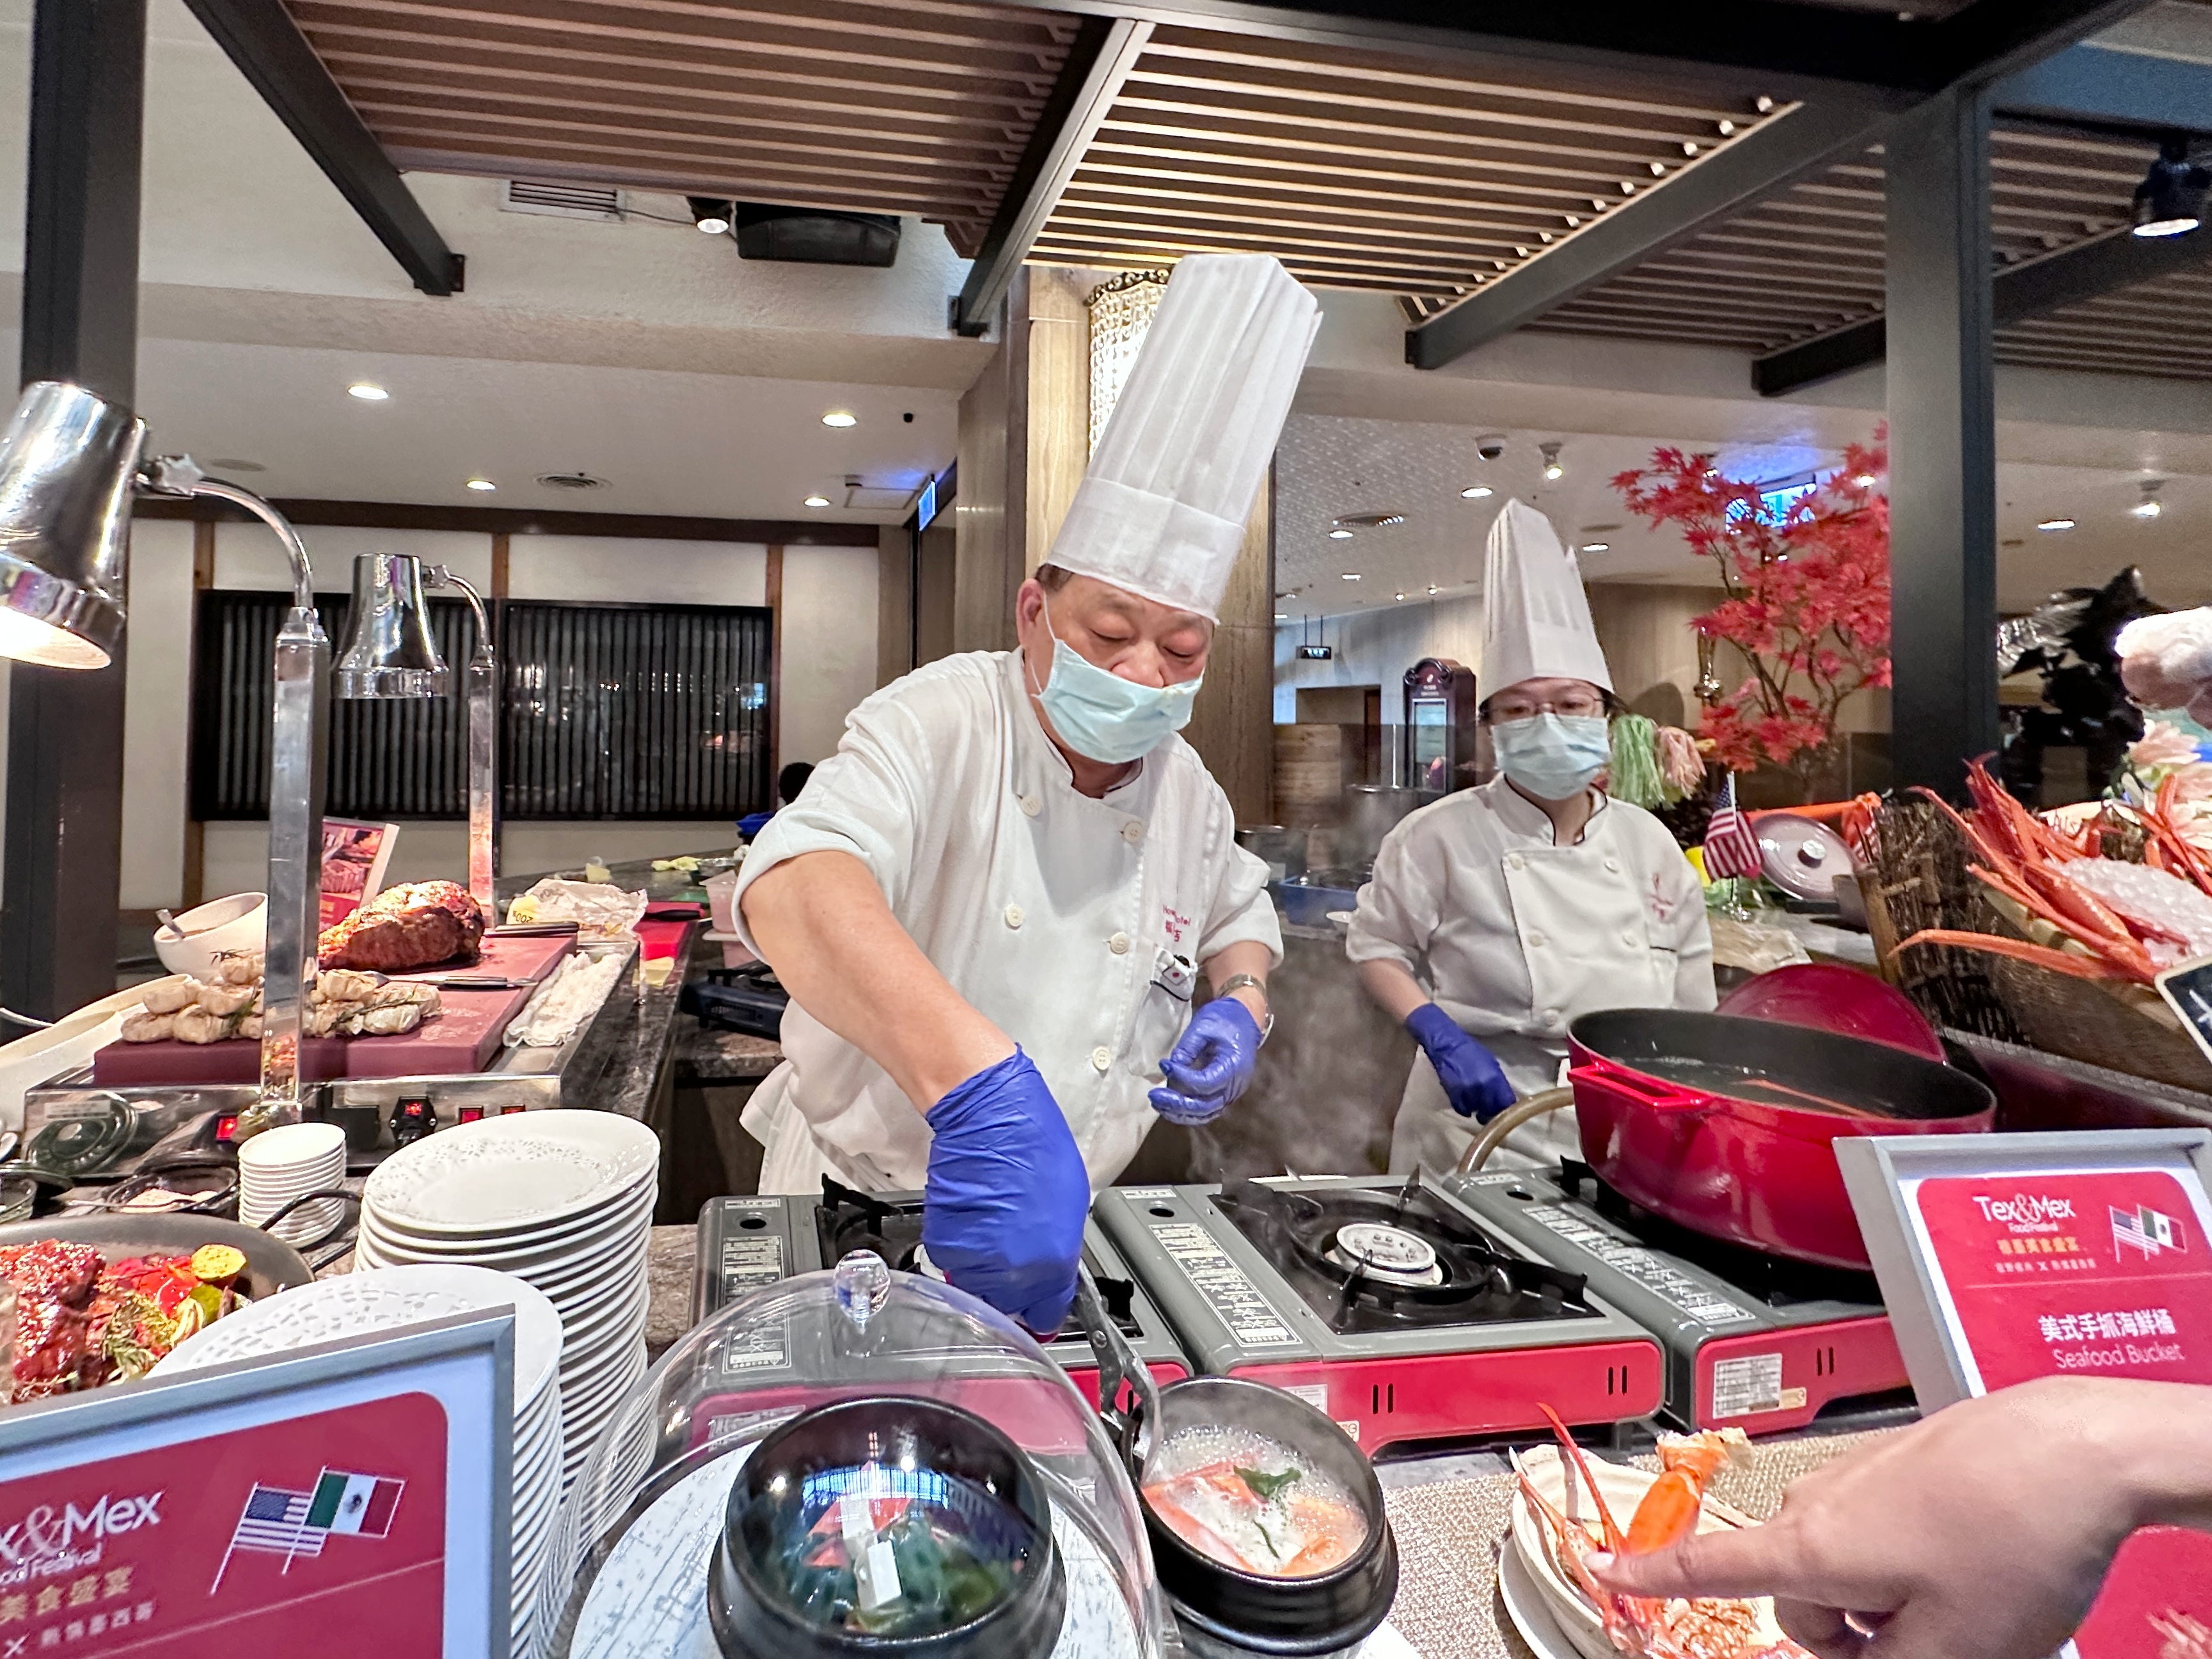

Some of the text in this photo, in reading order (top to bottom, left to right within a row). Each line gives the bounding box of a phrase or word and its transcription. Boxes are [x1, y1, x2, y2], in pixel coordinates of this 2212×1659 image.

[1972, 1193, 2077, 1223] Tex&Mex
[2038, 1309, 2177, 1342] 美式手抓海鮮桶
[2052, 1341, 2186, 1369] Seafood Bucket
